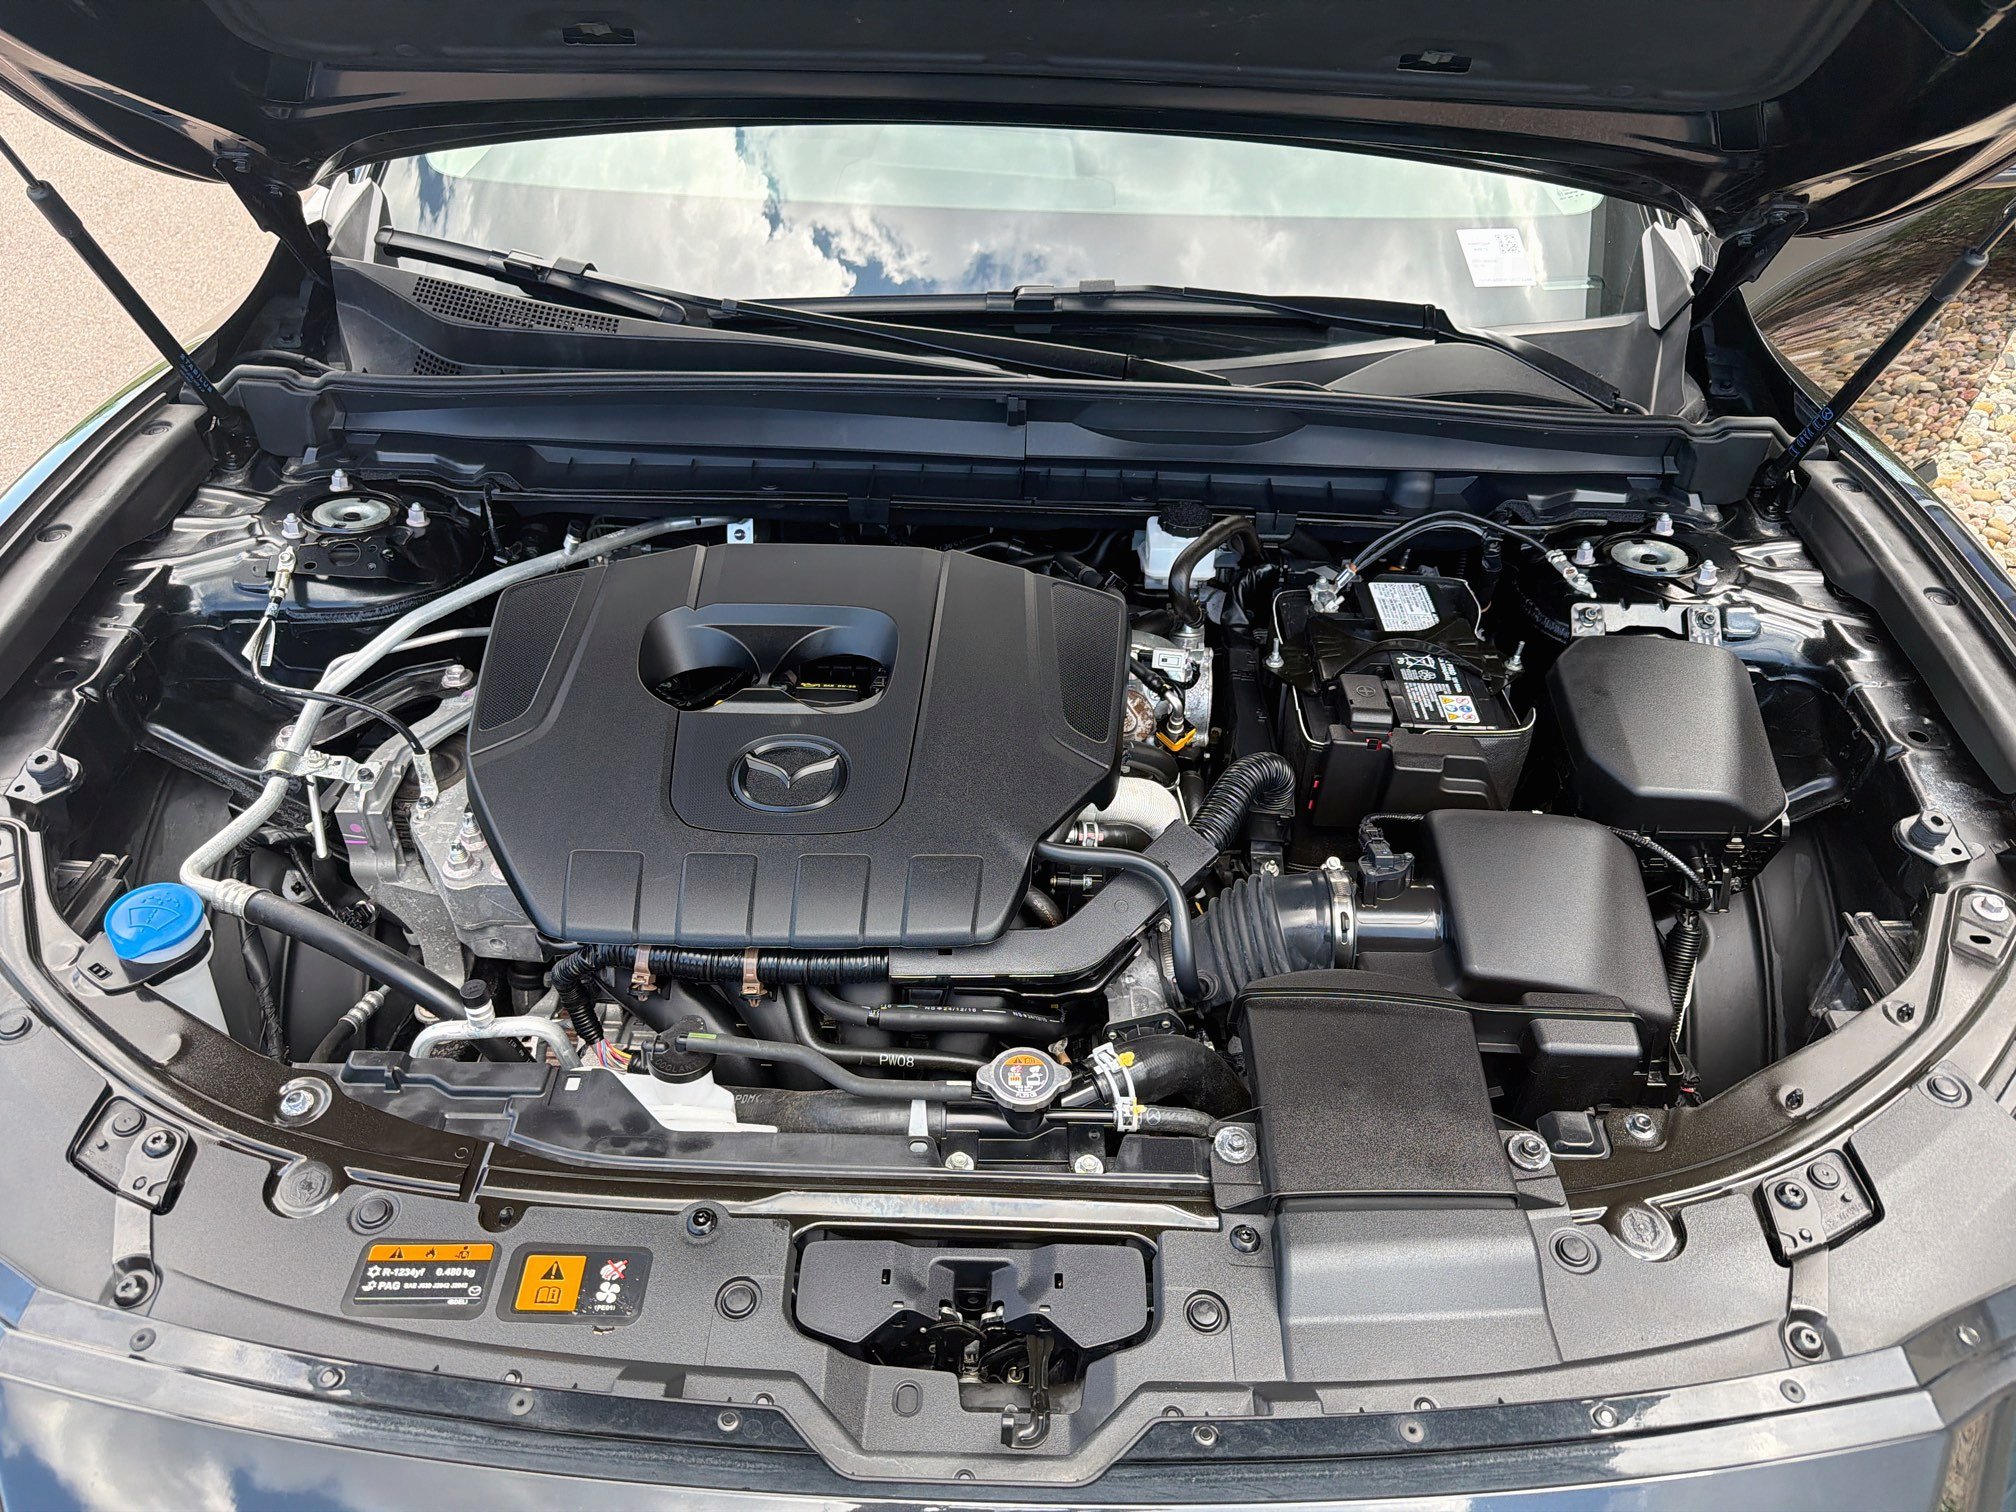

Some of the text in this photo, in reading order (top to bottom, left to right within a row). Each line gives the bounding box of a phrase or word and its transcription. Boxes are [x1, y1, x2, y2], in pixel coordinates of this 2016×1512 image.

[179, 353, 213, 392] STABILUS
[655, 1058, 698, 1073] COOLANT
[879, 1053, 915, 1068] PW08
[381, 1267, 476, 1278] R-1234yf 0.480 kg
[377, 1281, 401, 1290] PAG
[594, 1304, 616, 1312] (PE01)
